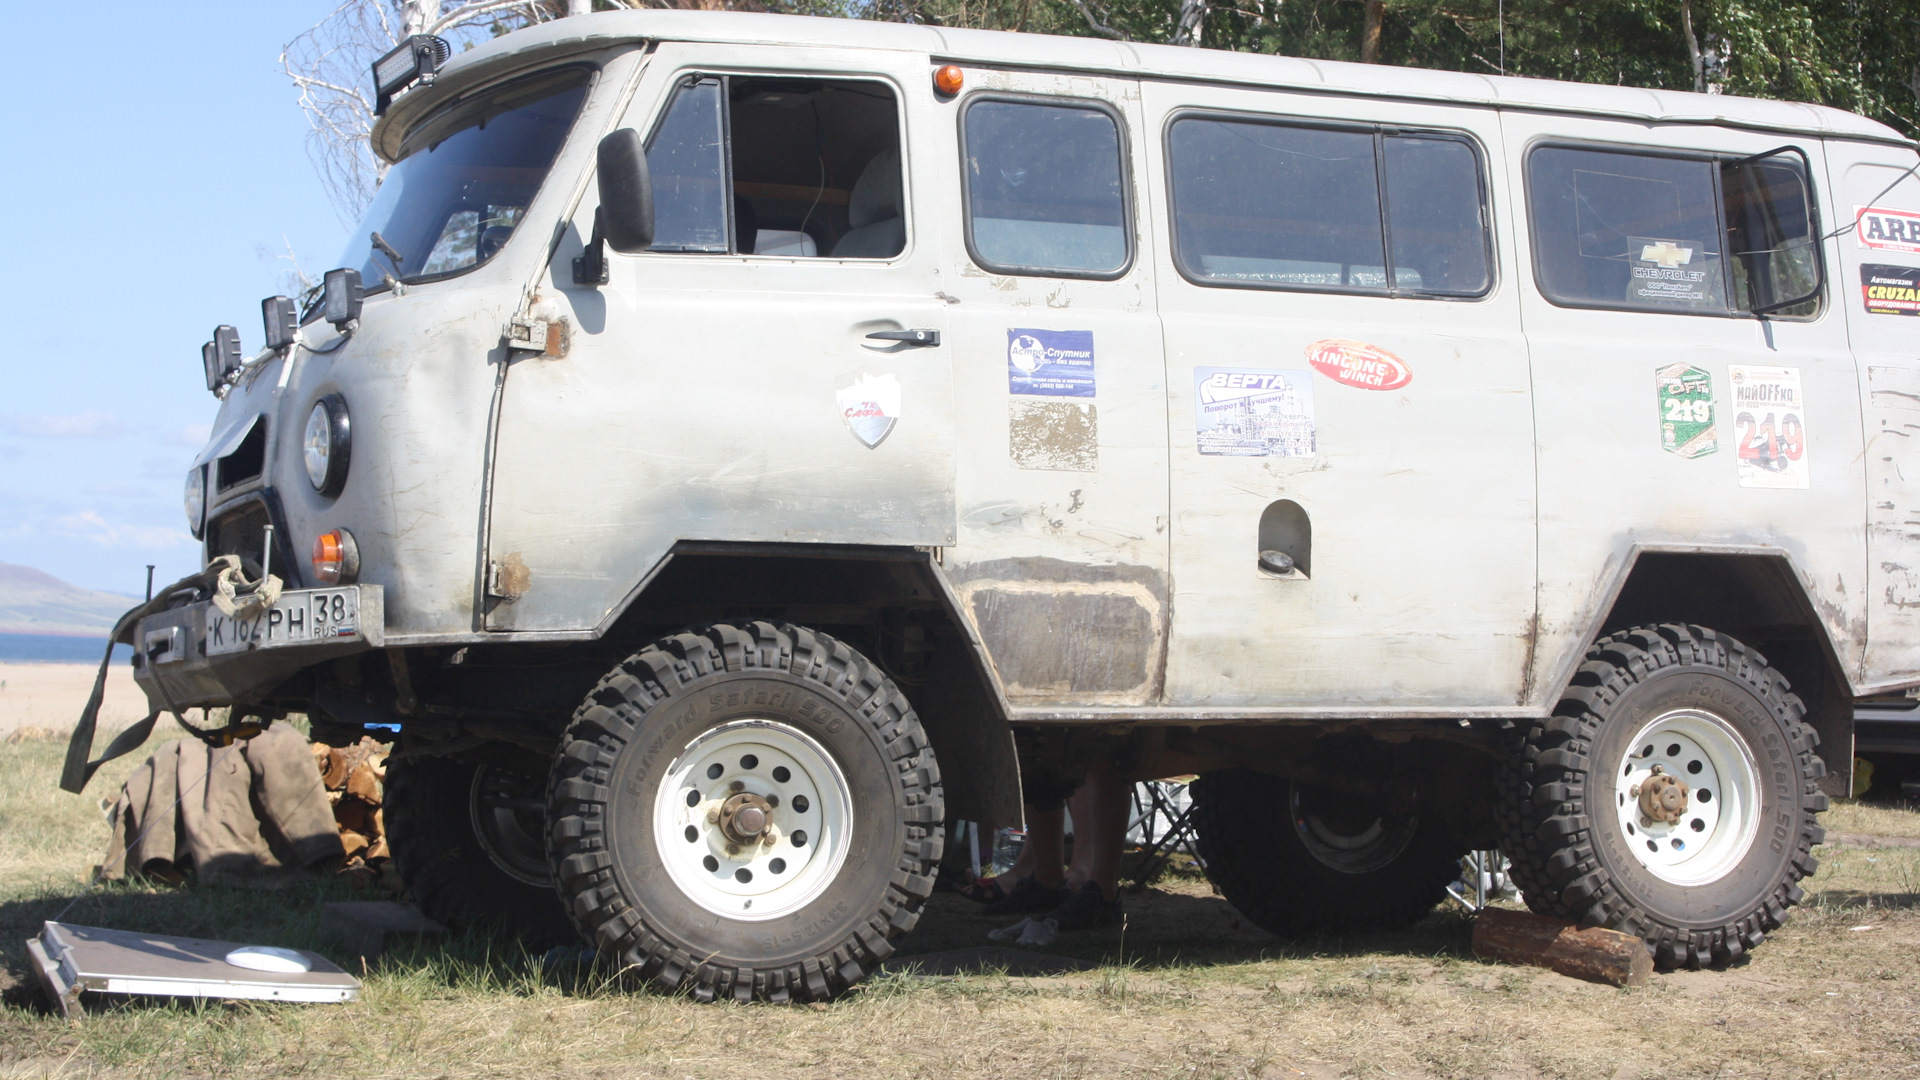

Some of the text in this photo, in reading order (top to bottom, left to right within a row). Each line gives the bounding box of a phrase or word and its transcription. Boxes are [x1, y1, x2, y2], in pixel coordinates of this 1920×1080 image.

[1633, 267, 1705, 282] CHEVROLET
[1871, 275, 1913, 285] Автомагазин
[1868, 300, 1916, 310] ОБОРУДОВАНИЕ
[1012, 347, 1091, 359] Астро-Спутник
[1311, 350, 1388, 376] KINGONE
[1210, 373, 1287, 391] ВЕРТА
[1340, 370, 1384, 386] WINCH
[1203, 402, 1238, 414] Поворот
[1664, 398, 1710, 423] 219
[1736, 411, 1804, 461] 219
[314, 593, 347, 624] 38
[313, 626, 338, 639] RUS
[625, 690, 846, 798] Forward Safari 500
[1688, 680, 1791, 854] Forward Safari 500
